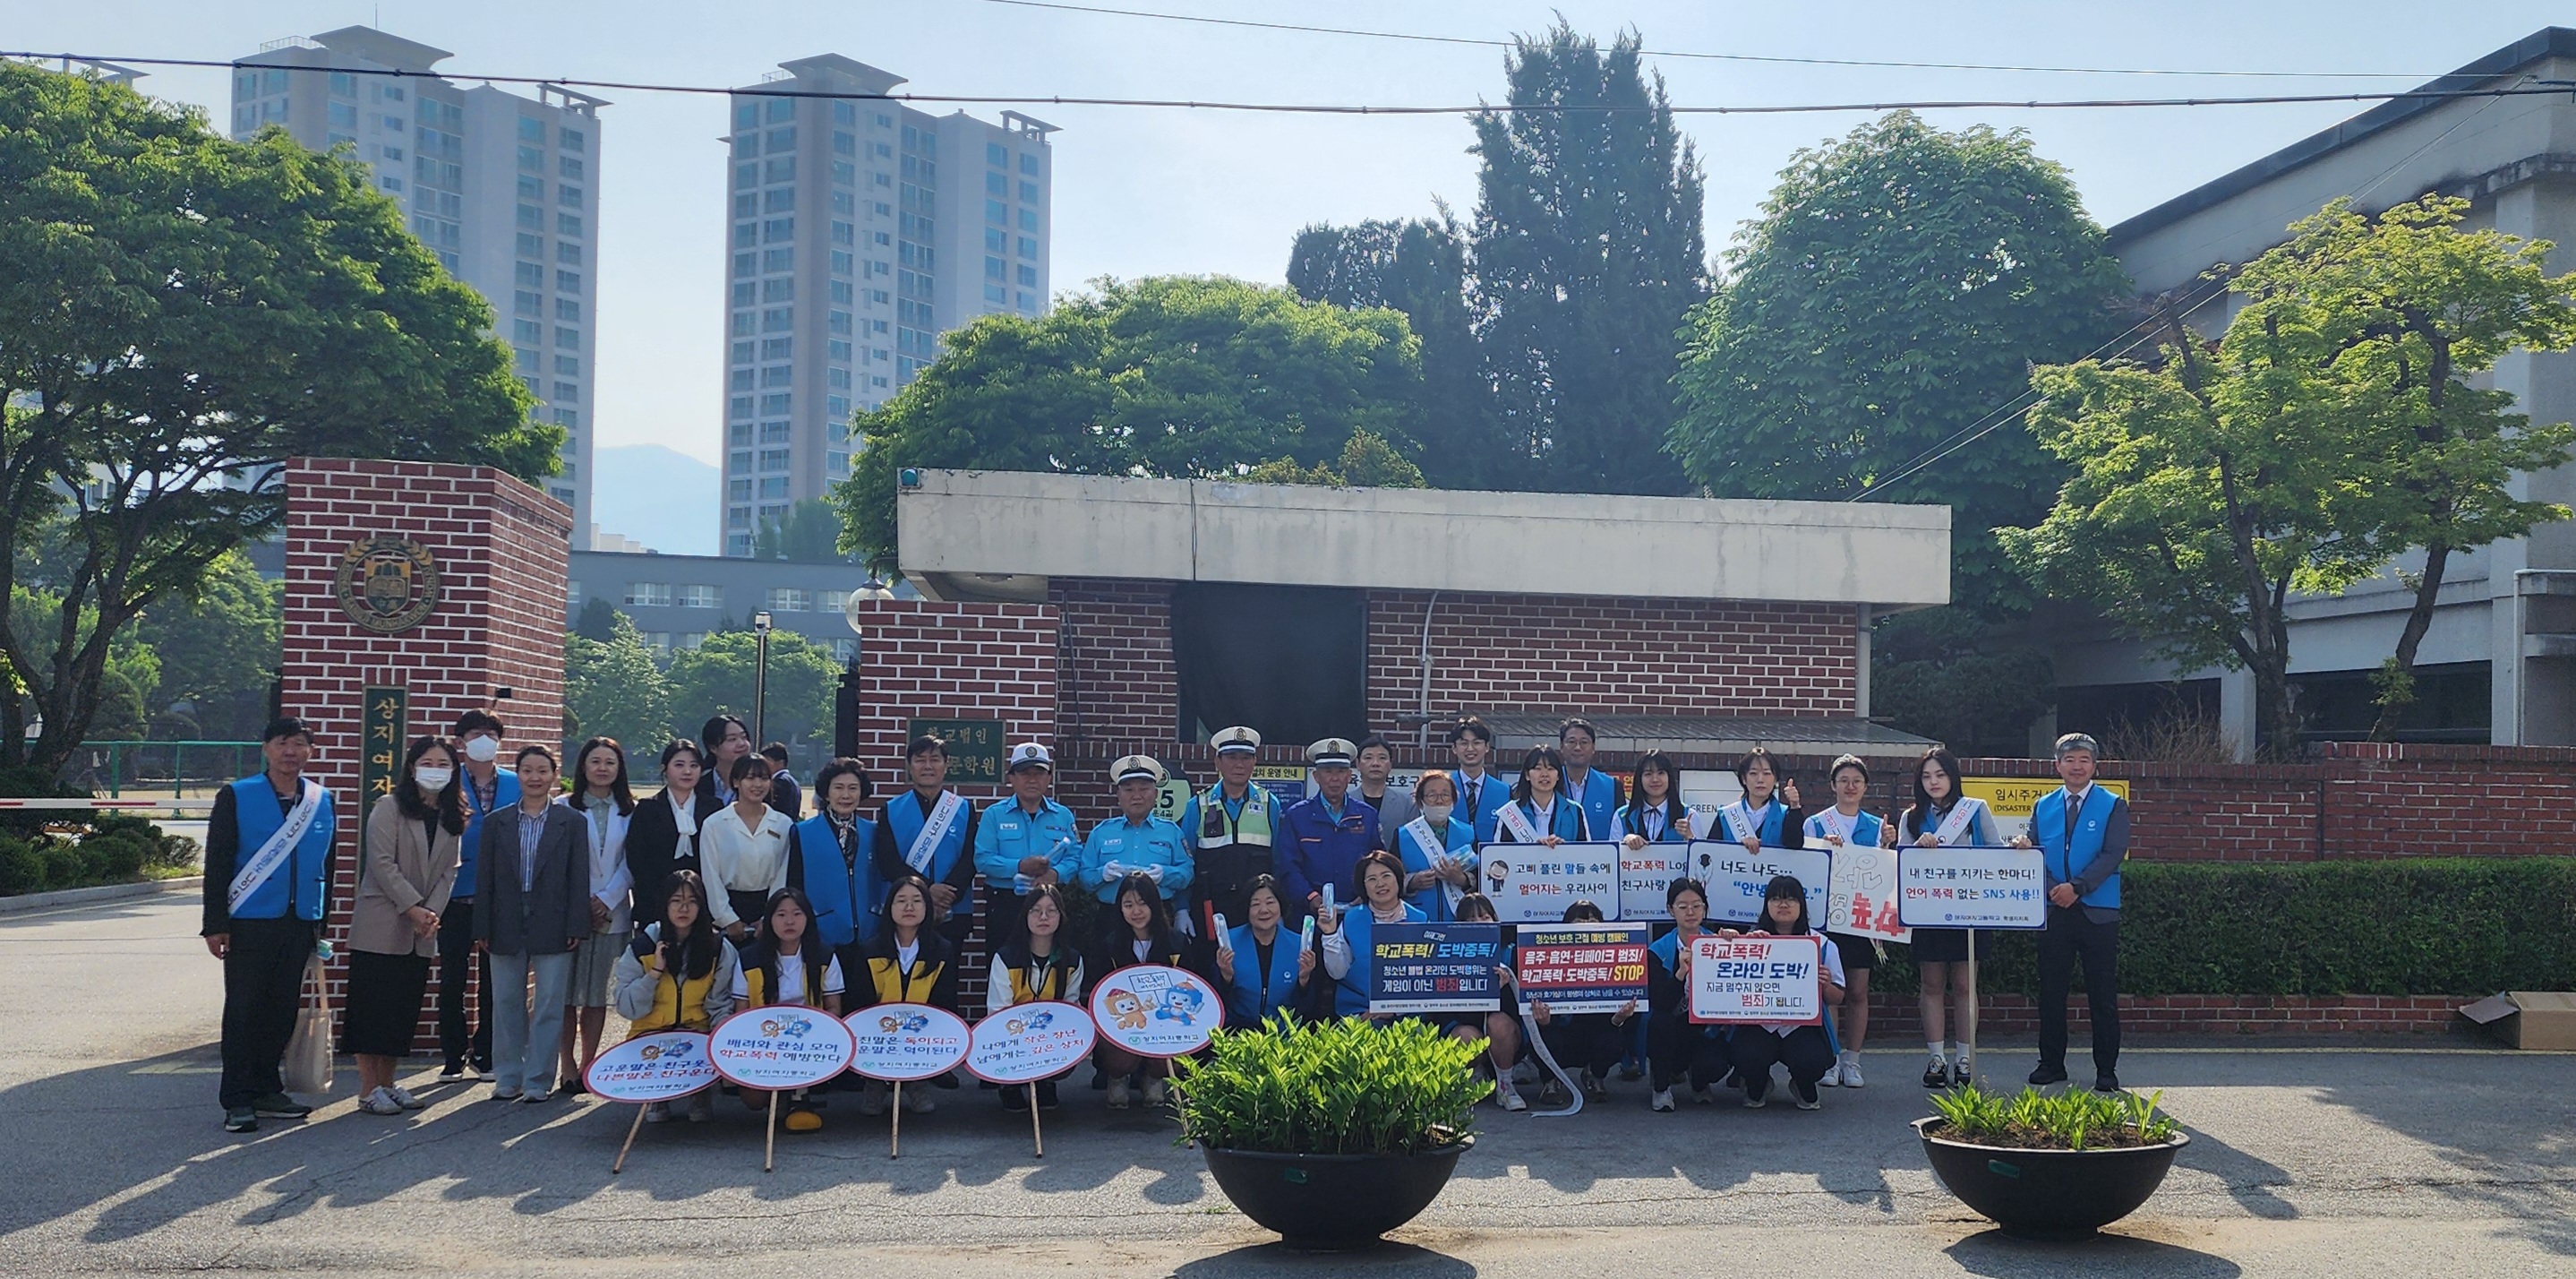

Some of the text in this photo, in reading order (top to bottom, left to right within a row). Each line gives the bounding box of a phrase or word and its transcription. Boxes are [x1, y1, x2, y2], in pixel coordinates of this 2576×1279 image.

[1622, 861, 1665, 871] 학교폭력
[1721, 861, 1747, 874] 너도
[1910, 868, 2035, 880] 내 친구를 지키는 한마디!
[1565, 883, 1607, 895] 우리사이
[1622, 880, 1665, 891] 친구사랑
[1905, 888, 2040, 900] 언어 폭력 없는 SNS 사용!!
[1536, 933, 1557, 944] 청소년
[1559, 933, 1573, 943] 보호
[1375, 943, 1497, 958] 학교폭력! 도박중독!
[1618, 949, 1644, 963] 범죄!
[1700, 943, 1772, 959] 학교폭력!
[1383, 966, 1407, 975] 청소년
[1425, 965, 1447, 975] 온라인
[1613, 965, 1644, 982] STOP
[1716, 963, 1809, 979] 온라인 도박!
[1382, 979, 1411, 992] 게임이
[1414, 979, 1433, 991] 아닌
[1707, 982, 1781, 993] 지금 멈추지 않으면
[1742, 994, 1805, 1008] 범죄가 됩니다.
[727, 1039, 770, 1050] 배려와
[776, 1041, 804, 1051] 관심
[982, 1039, 1019, 1050] 나에게
[720, 1049, 842, 1063] 학교폭력 예방한다
